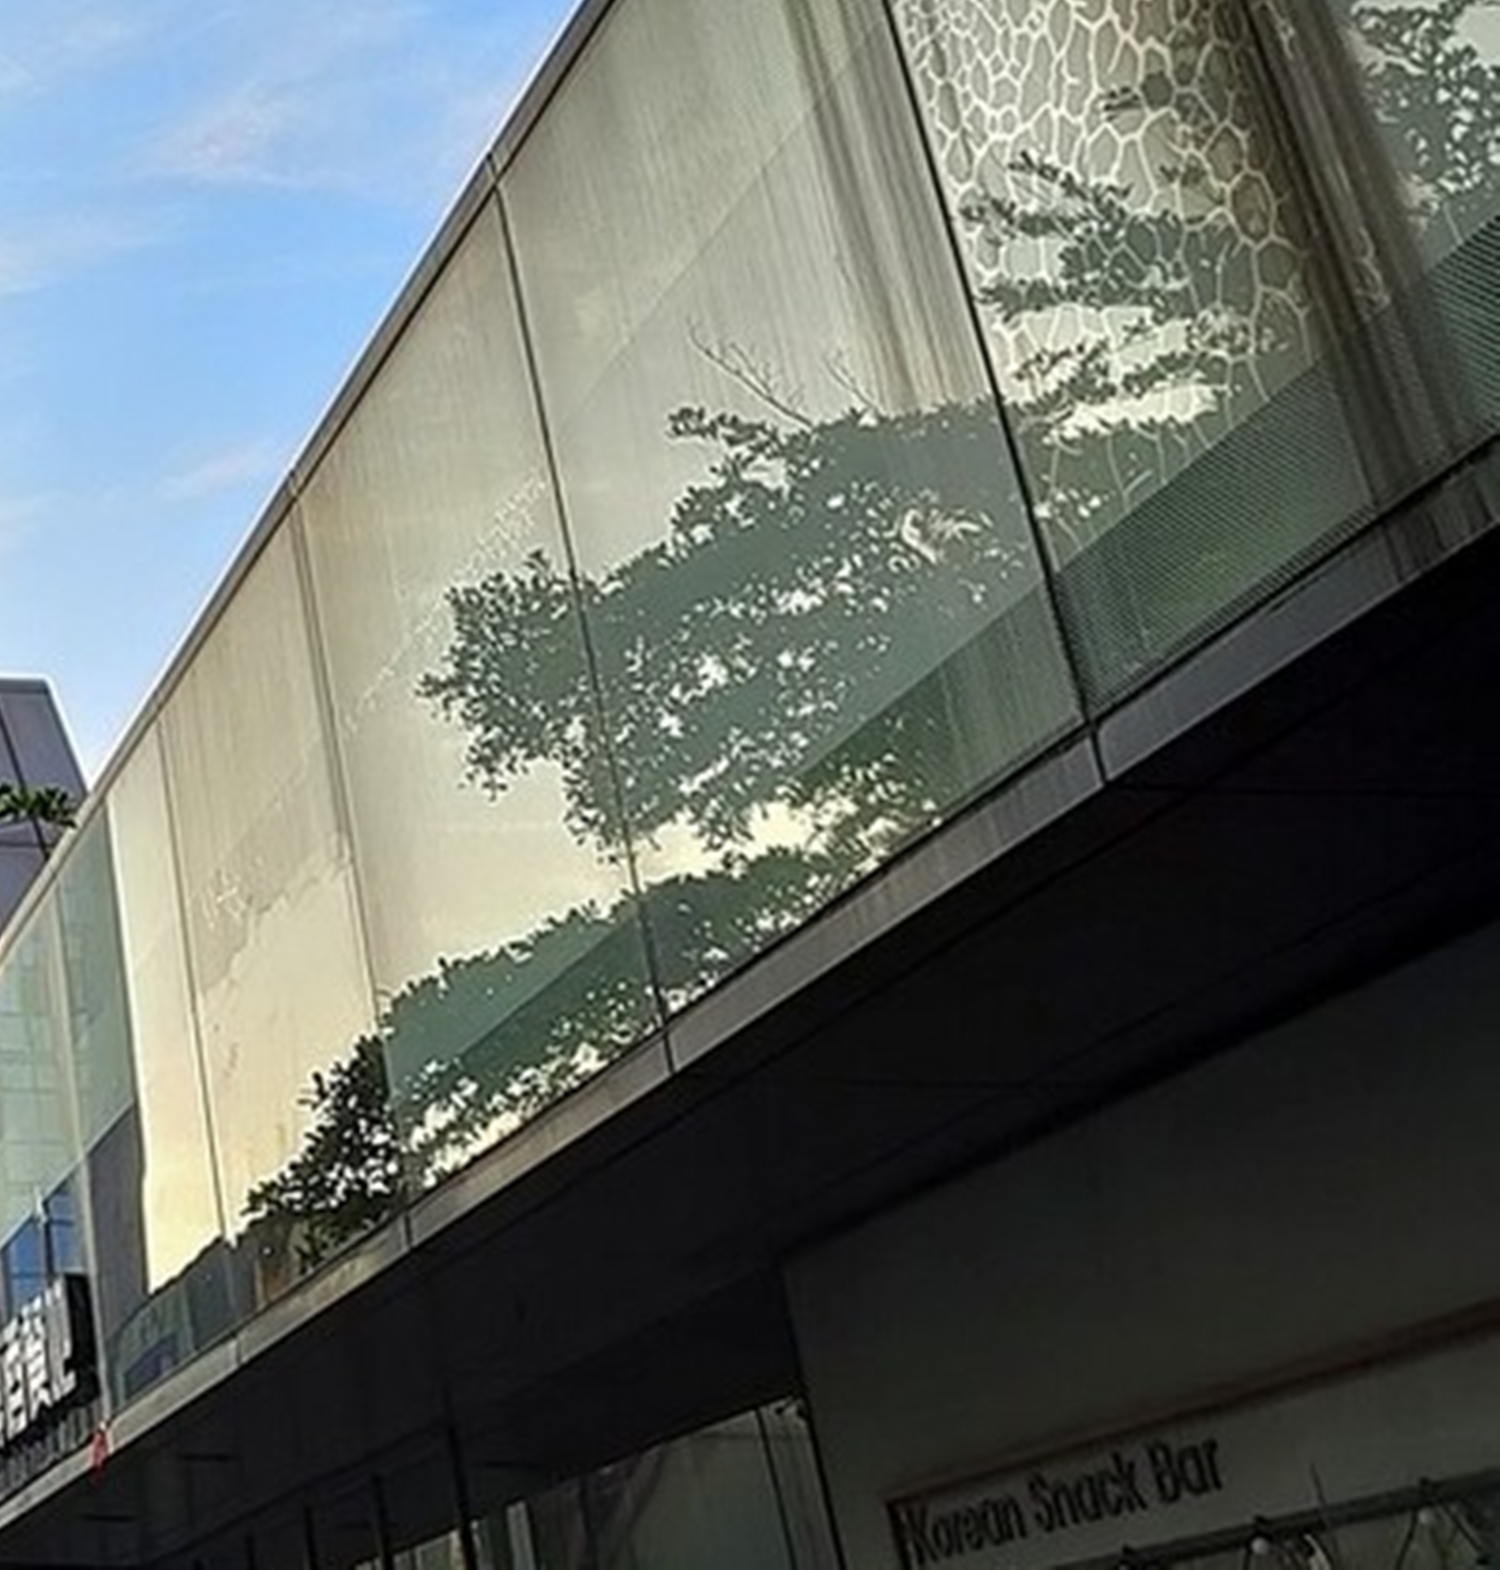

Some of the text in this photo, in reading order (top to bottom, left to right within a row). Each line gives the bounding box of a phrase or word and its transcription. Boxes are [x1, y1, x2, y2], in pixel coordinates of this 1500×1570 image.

[905, 1438, 1223, 1566] Korean Snack Bar
